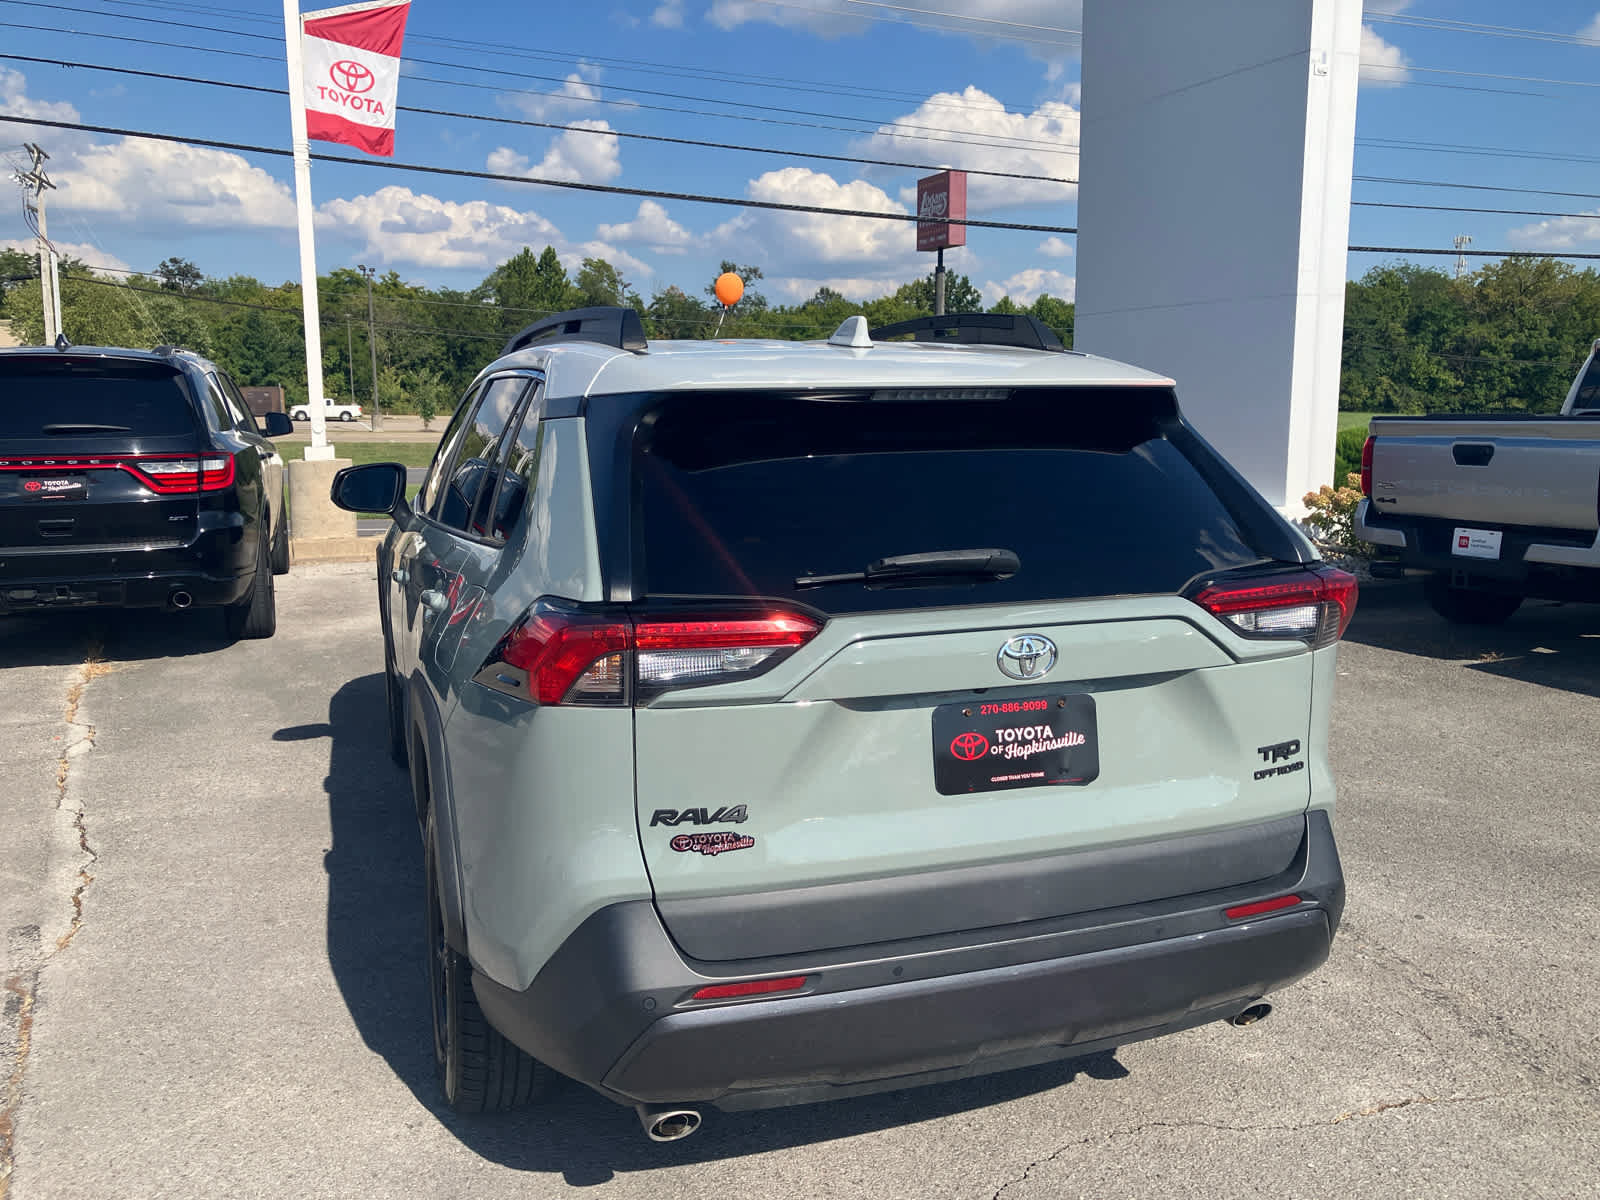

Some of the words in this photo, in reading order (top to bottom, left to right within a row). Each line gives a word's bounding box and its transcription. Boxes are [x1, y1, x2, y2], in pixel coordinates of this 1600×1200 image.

[317, 85, 385, 115] TOYOTA
[980, 699, 1048, 715] 270-886-9099
[990, 744, 1004, 755] OF
[1004, 731, 1086, 760] Hopkinsville
[995, 725, 1054, 743] TOYOTA
[1257, 739, 1301, 764] TRD
[649, 804, 748, 827] RAV4
[692, 832, 735, 845] TOYOTA
